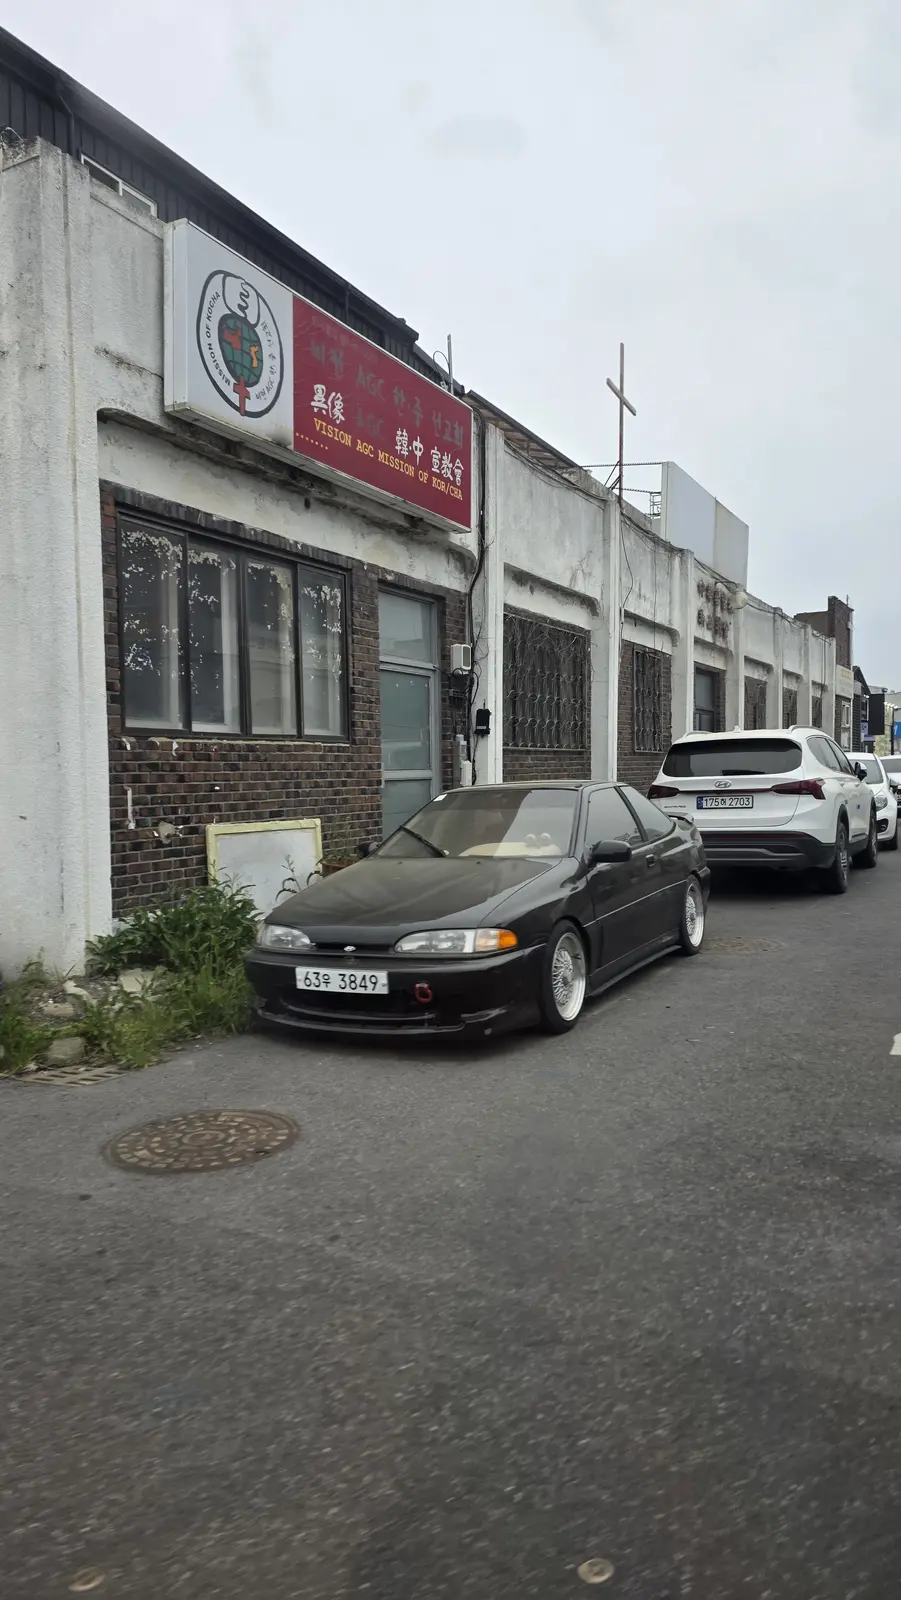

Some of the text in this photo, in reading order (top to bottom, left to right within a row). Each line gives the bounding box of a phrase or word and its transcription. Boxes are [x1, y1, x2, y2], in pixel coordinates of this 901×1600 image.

[205, 291, 231, 387] MISSION OF KOCHA
[356, 364, 385, 401] AGC
[310, 383, 346, 425] 異像
[430, 445, 465, 487] 宣教會
[313, 417, 464, 501] VISION AGC MISSION OF KOR/CHA
[729, 797, 751, 806] 2703
[303, 971, 378, 991] 63우 3849
